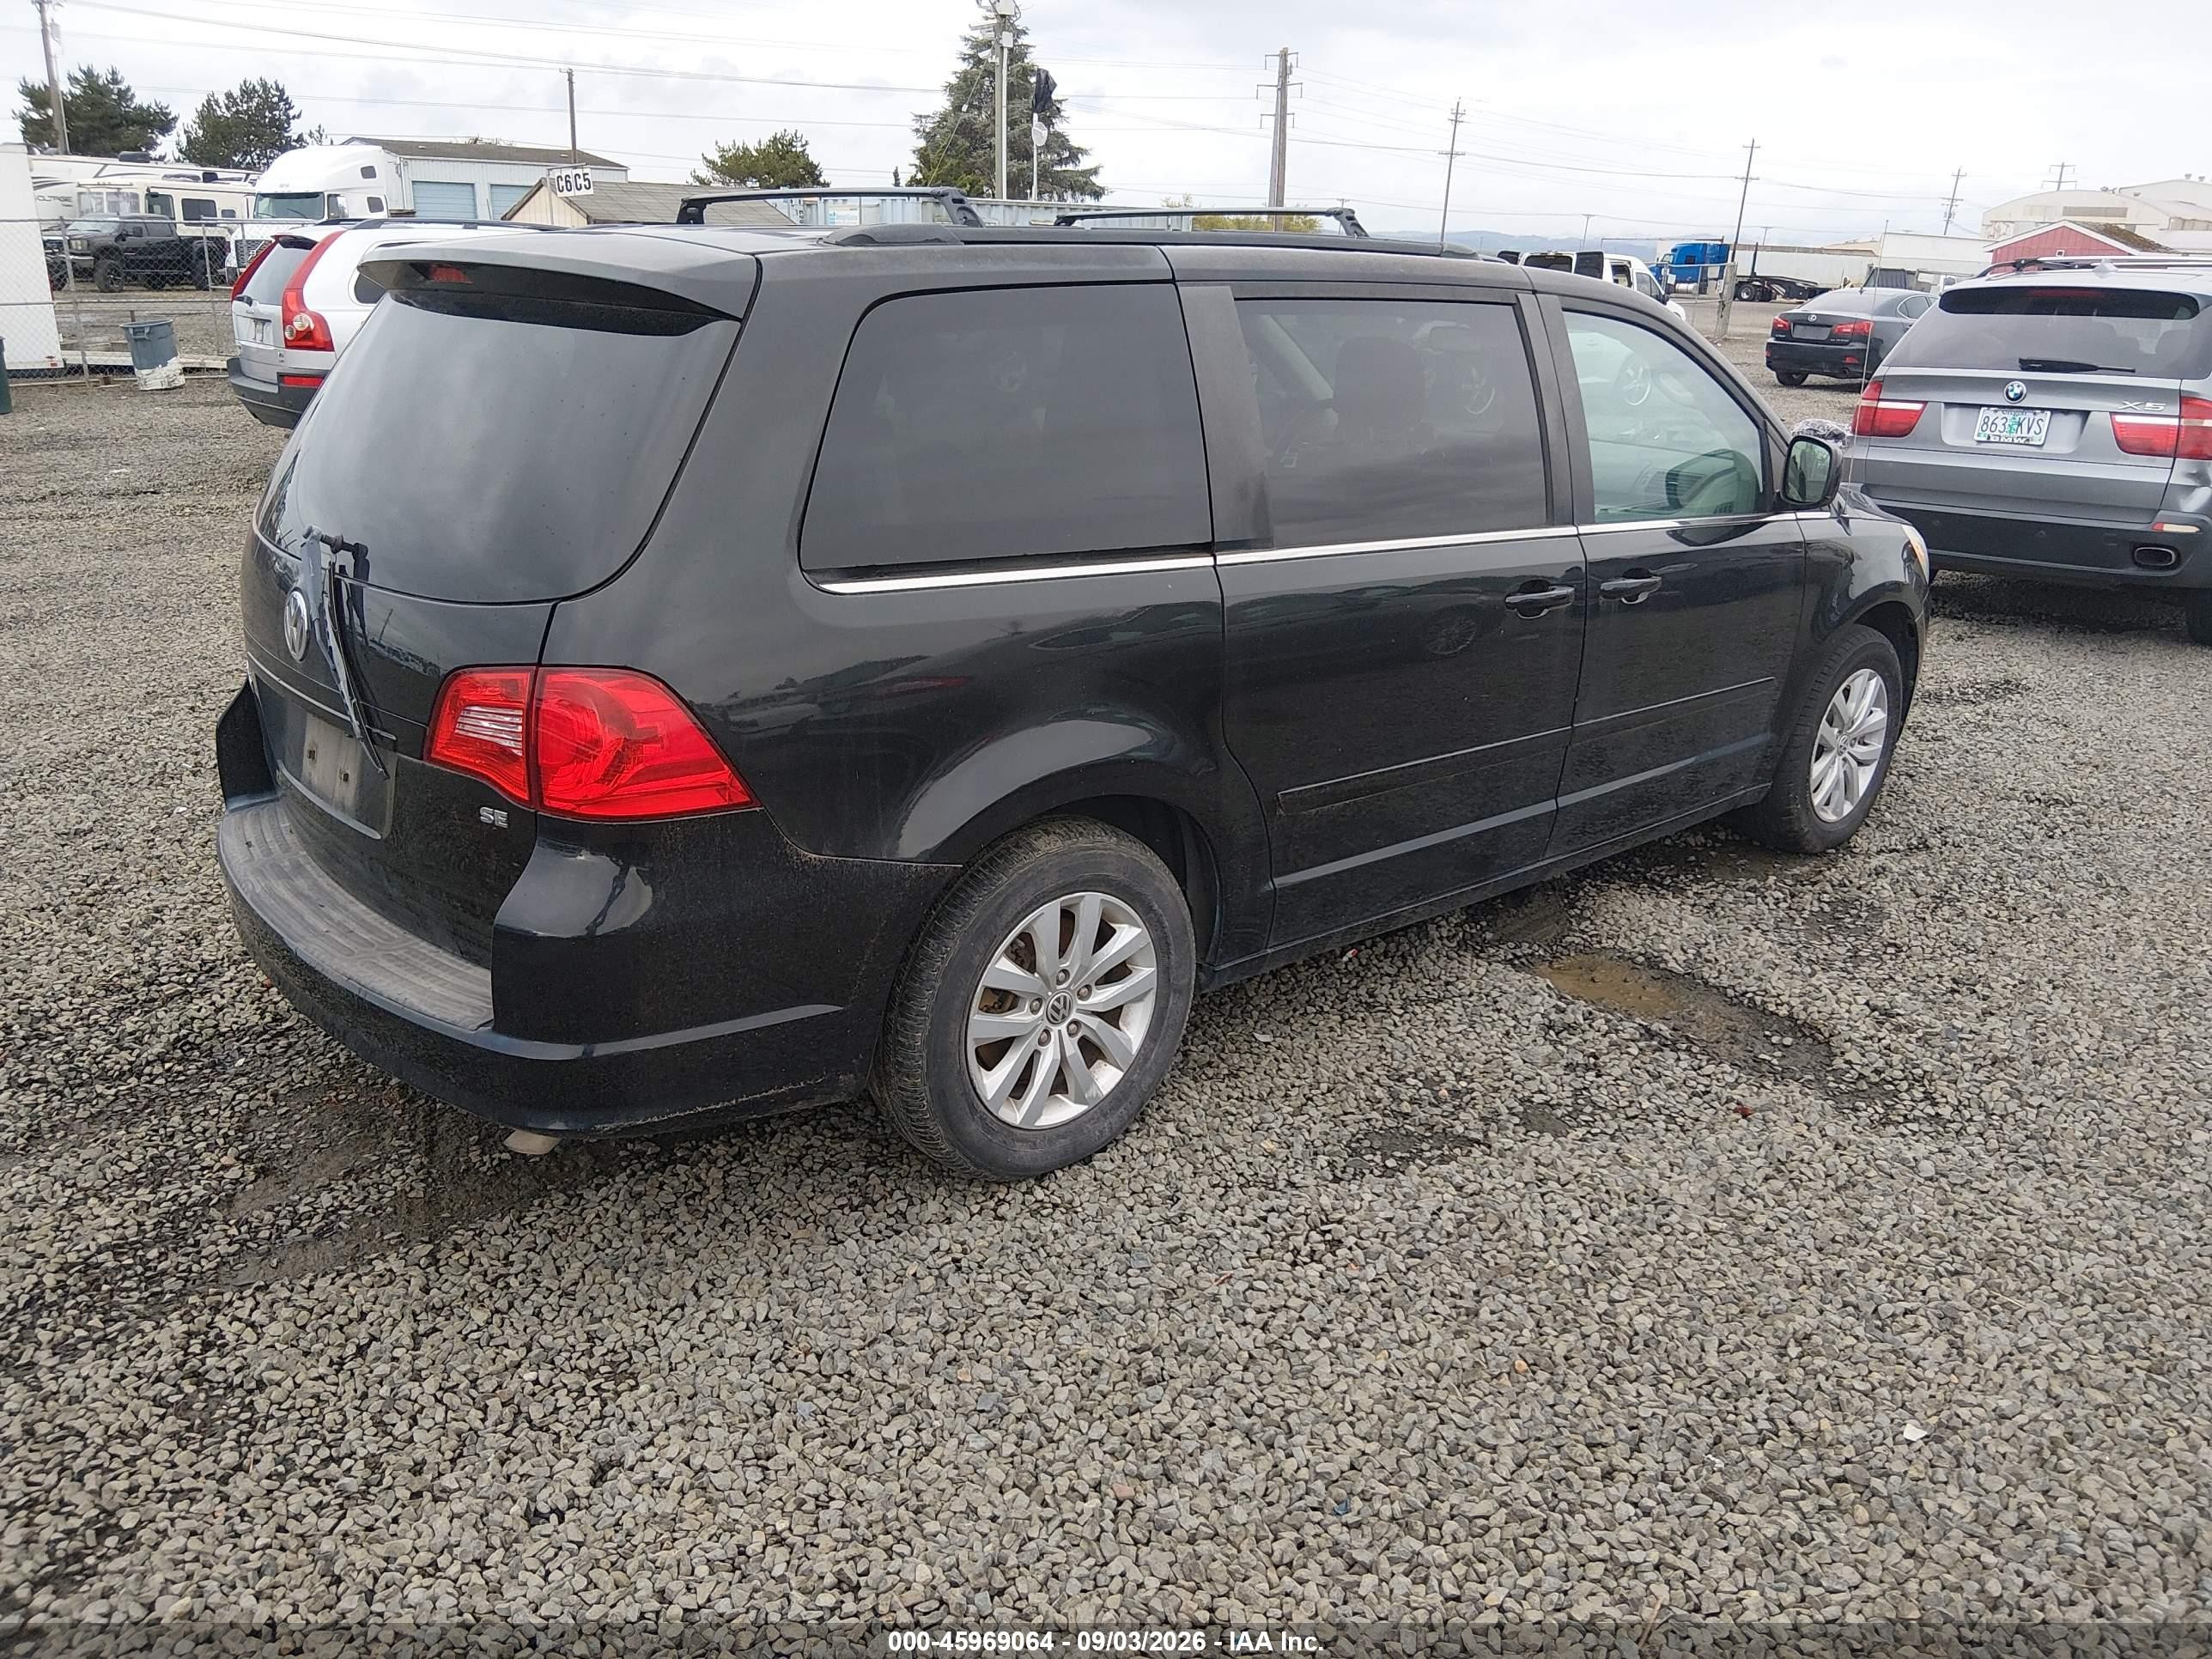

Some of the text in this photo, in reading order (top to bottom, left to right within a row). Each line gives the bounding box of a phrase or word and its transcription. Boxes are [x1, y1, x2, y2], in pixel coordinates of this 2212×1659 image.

[556, 173, 592, 193] C6 C5
[2117, 400, 2166, 411] X5
[1980, 416, 2045, 435] 863 KVS
[480, 806, 508, 829] SE
